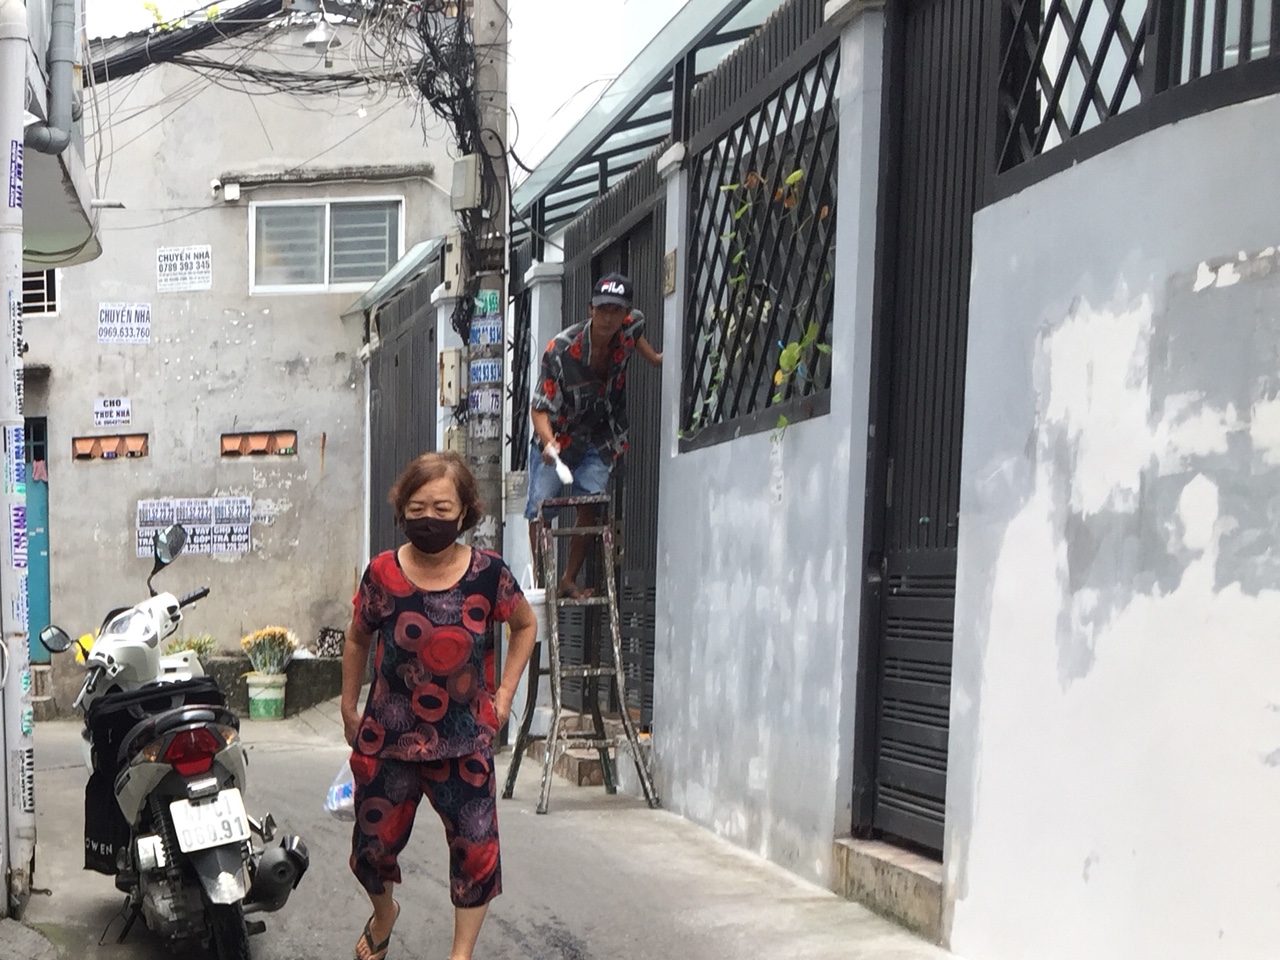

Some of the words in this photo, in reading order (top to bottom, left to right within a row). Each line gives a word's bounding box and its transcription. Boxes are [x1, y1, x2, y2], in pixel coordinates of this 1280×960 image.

[158, 263, 178, 272] 0789
[601, 280, 625, 295] FILA
[103, 399, 122, 408] CHO
[195, 527, 211, 535] VAY
[213, 526, 230, 534] CHO
[233, 525, 248, 533] VAY
[86, 837, 113, 856] OWEN
